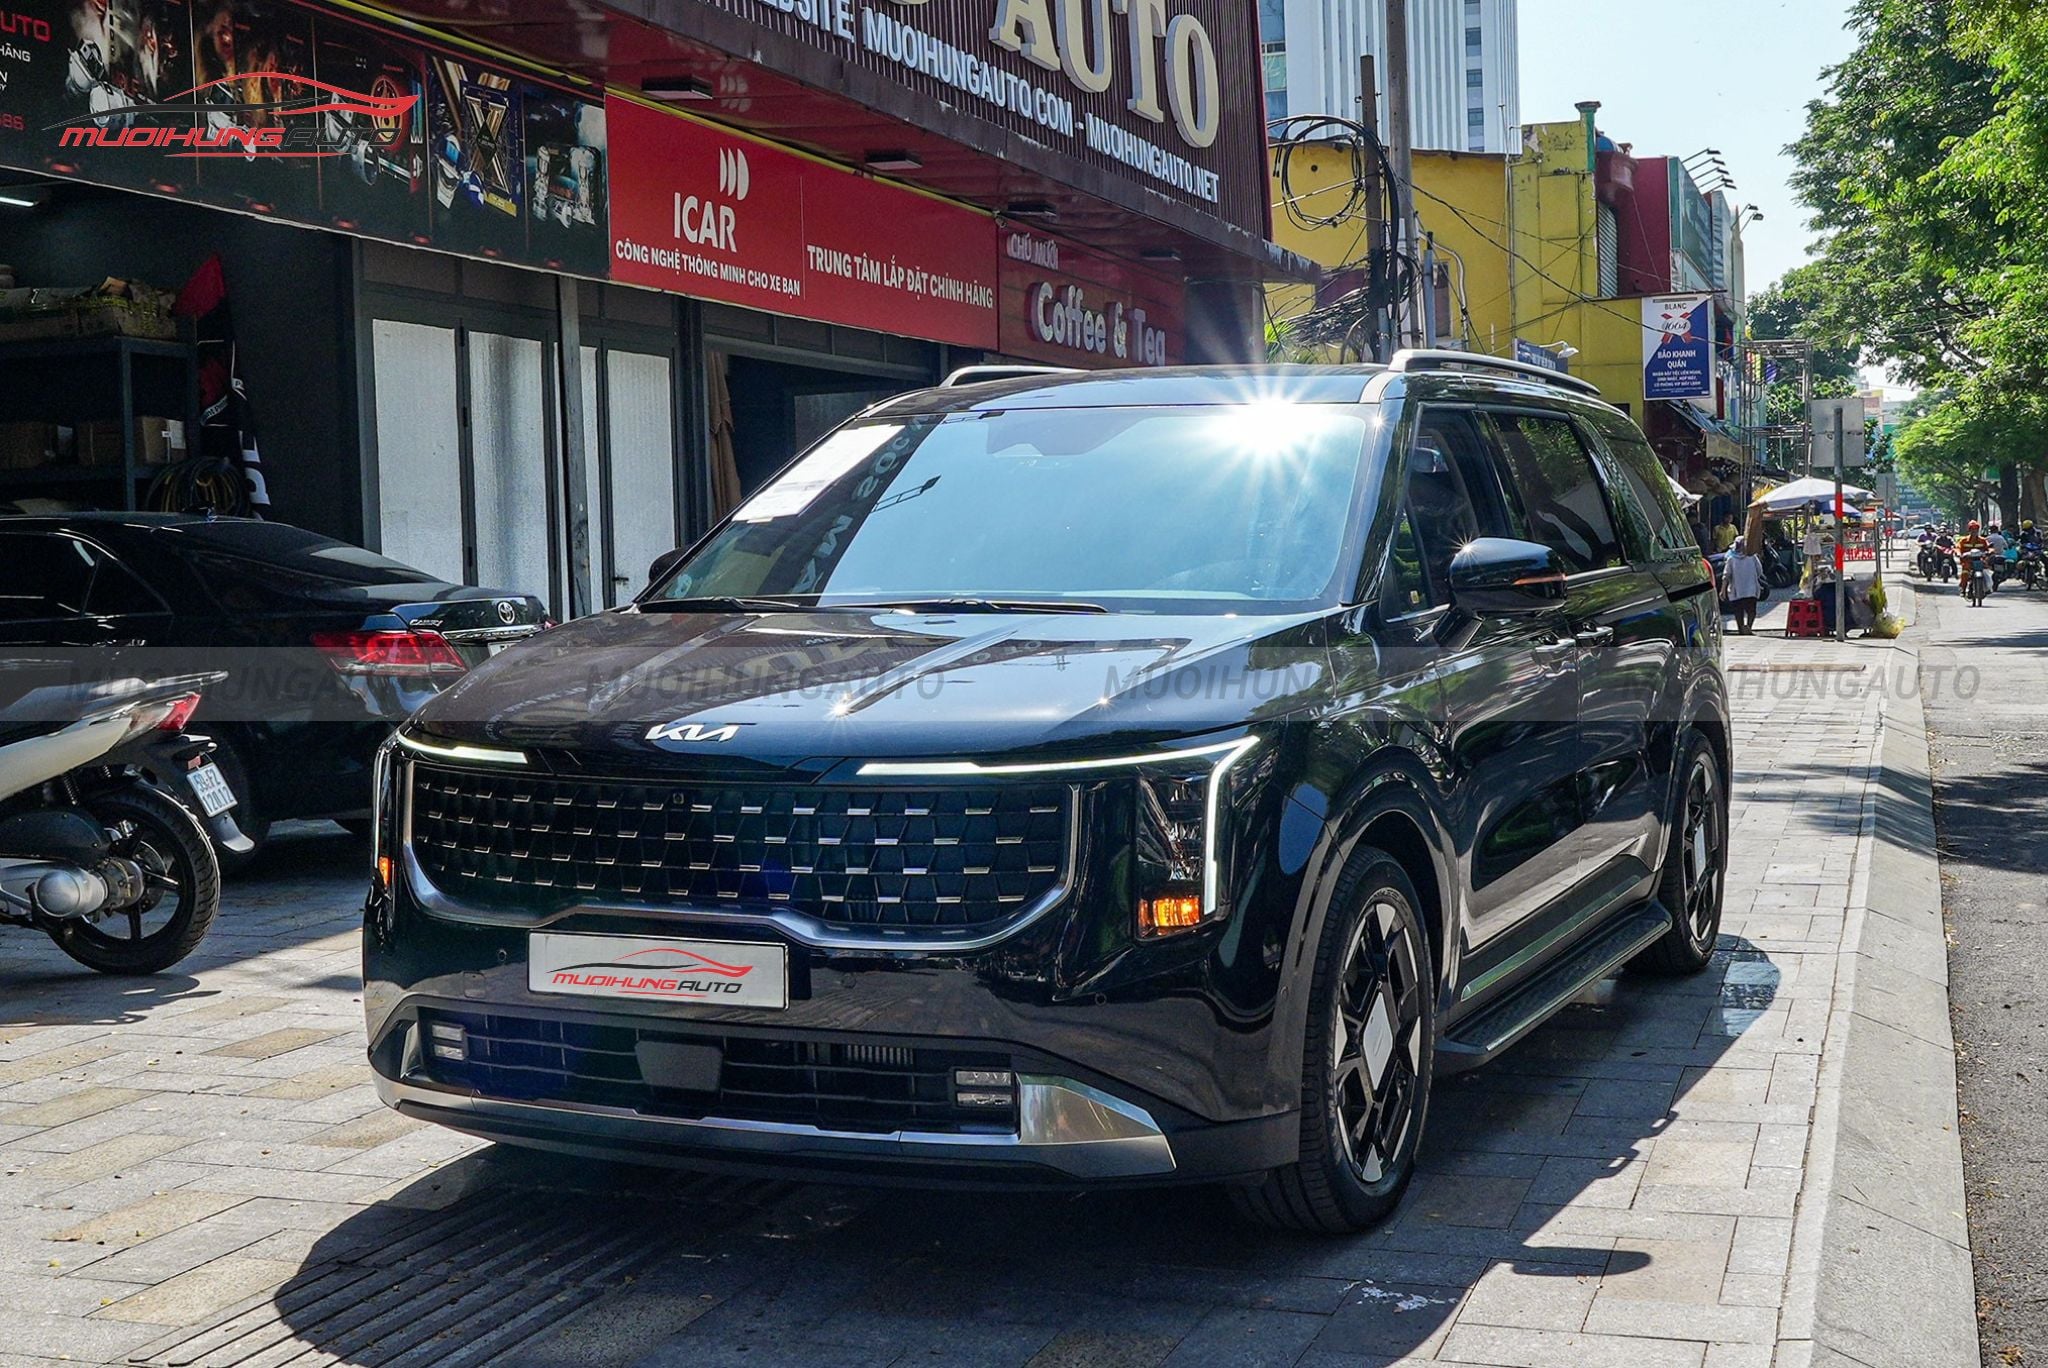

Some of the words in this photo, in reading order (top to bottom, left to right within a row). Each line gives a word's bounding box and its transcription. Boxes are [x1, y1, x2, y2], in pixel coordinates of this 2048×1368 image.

[674, 192, 737, 253] ICAR
[615, 238, 649, 264] CÔNG
[651, 248, 681, 275] NGHỆ
[682, 254, 718, 278] THÔNG
[720, 263, 746, 285] MINH
[747, 270, 768, 289] CHO
[769, 275, 781, 292] XE
[782, 280, 800, 299] BẠN
[807, 244, 852, 278] TRUNG
[854, 252, 881, 285] TÂM
[883, 255, 905, 289] LẮP
[907, 266, 929, 300] ĐẶT
[930, 272, 964, 302] CHÍNH
[1033, 281, 1106, 354] Coffee
[1113, 302, 1127, 359] &
[1129, 308, 1165, 366] Tea
[1672, 350, 1696, 358] KHANH
[645, 723, 741, 742] KIA
[552, 973, 743, 994] MUOIHUNGAUTO
